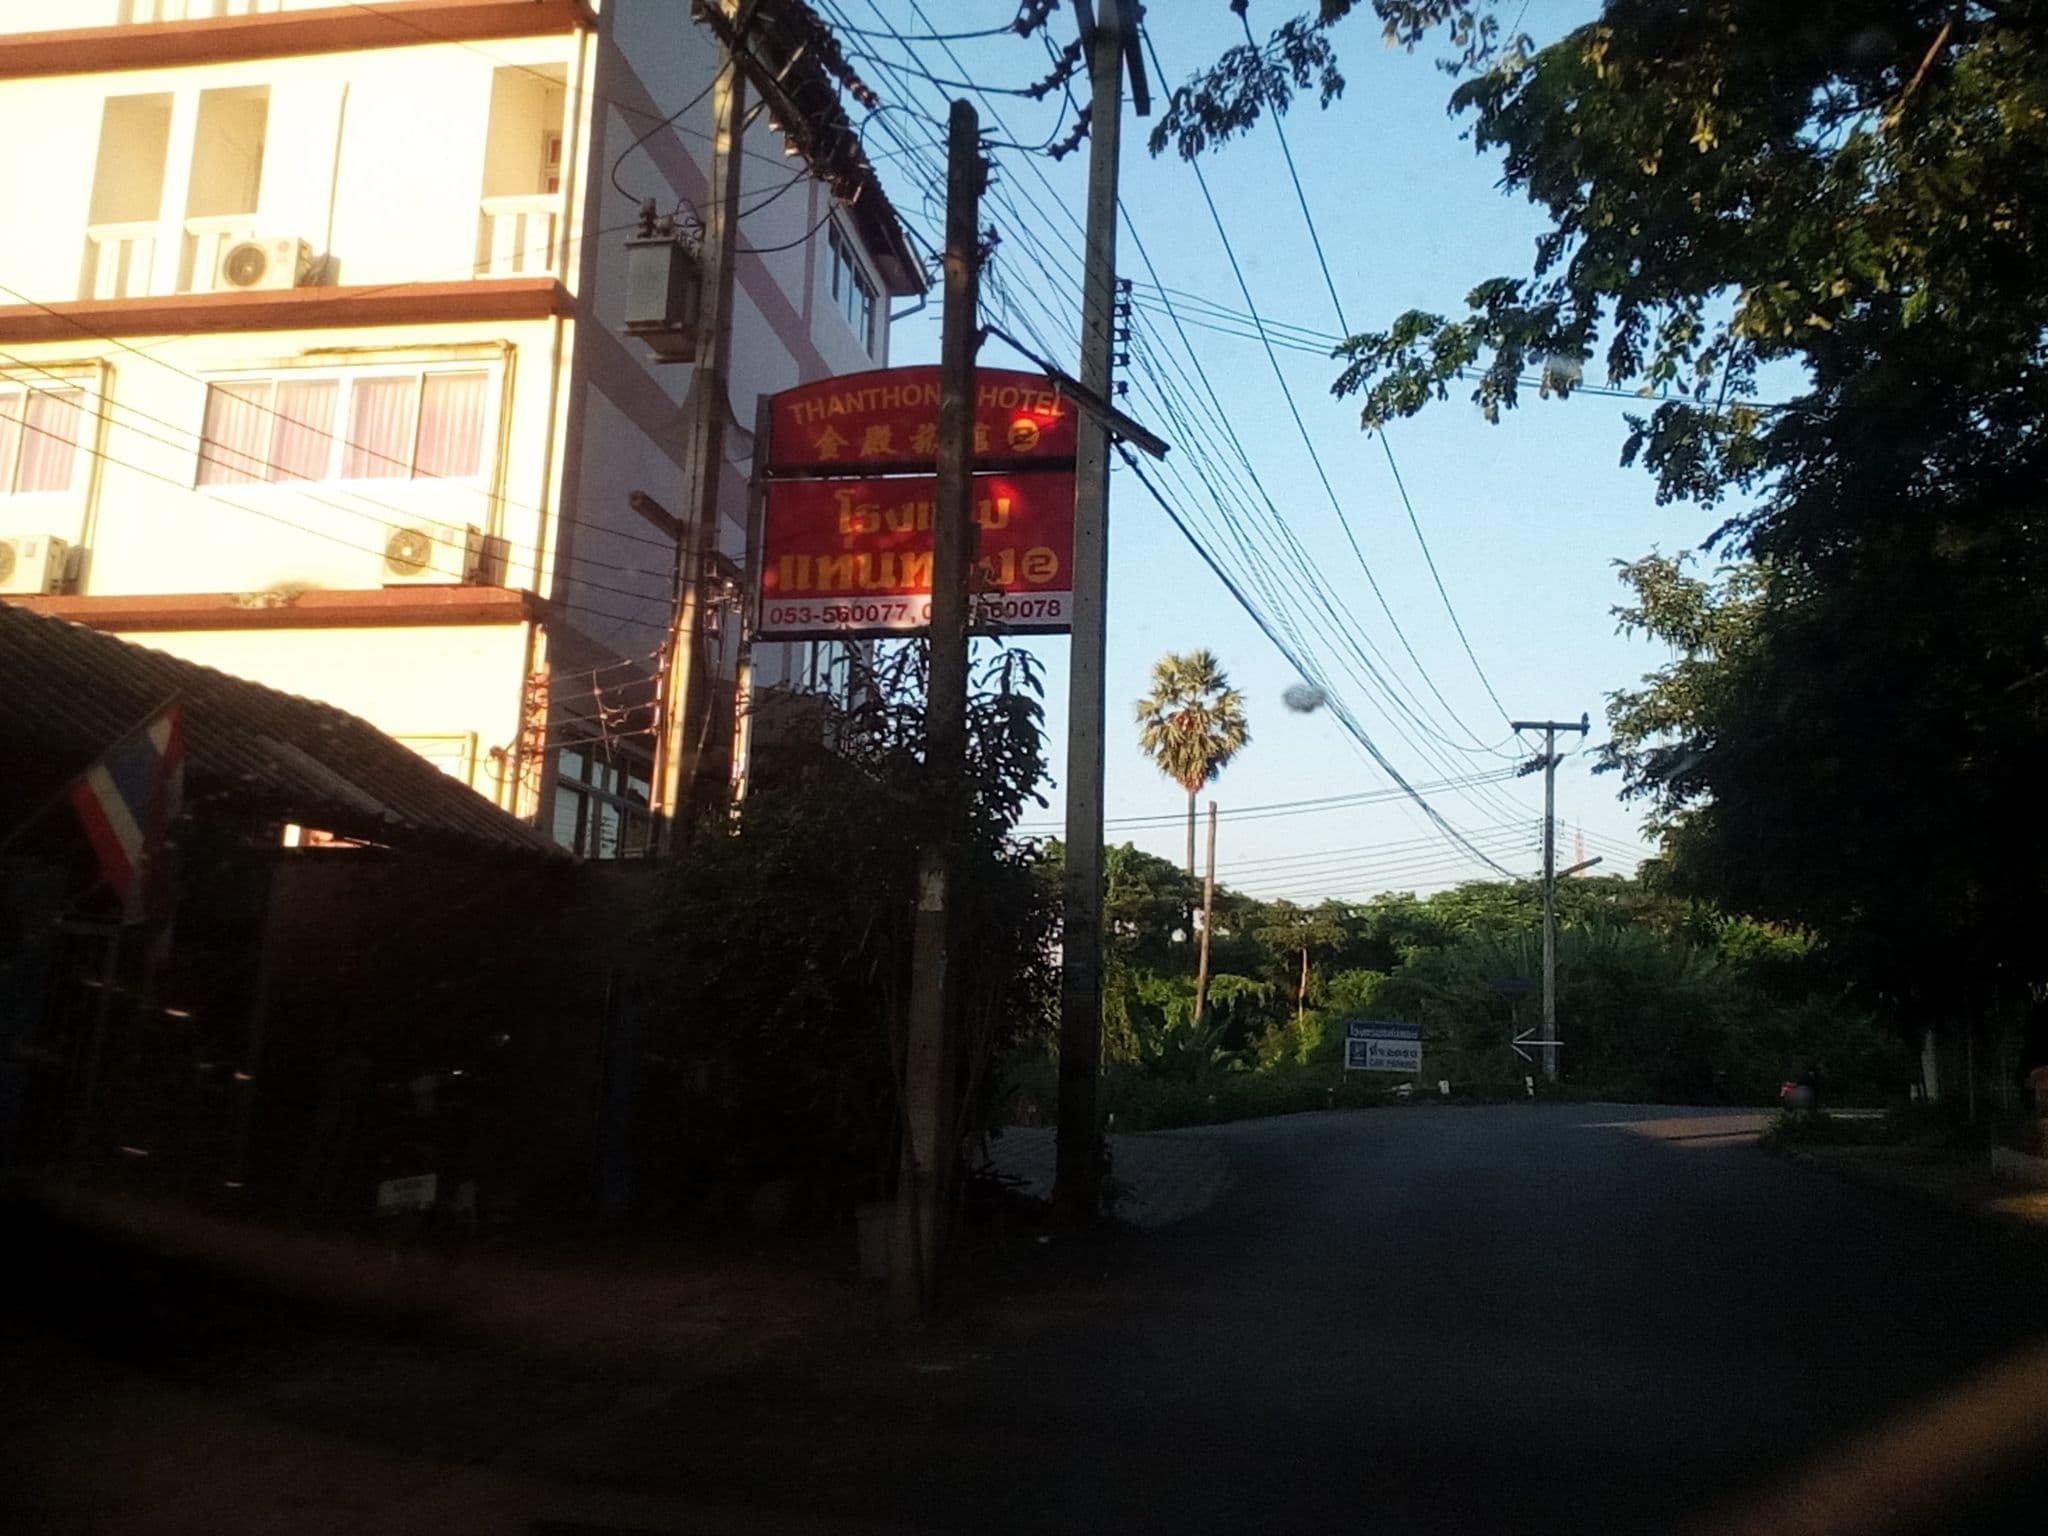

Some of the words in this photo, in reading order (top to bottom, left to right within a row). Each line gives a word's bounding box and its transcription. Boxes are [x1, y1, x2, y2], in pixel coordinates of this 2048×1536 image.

[789, 382, 945, 425] THANTHON
[978, 385, 1066, 418] HOTEL
[834, 488, 1011, 535] โรงแม
